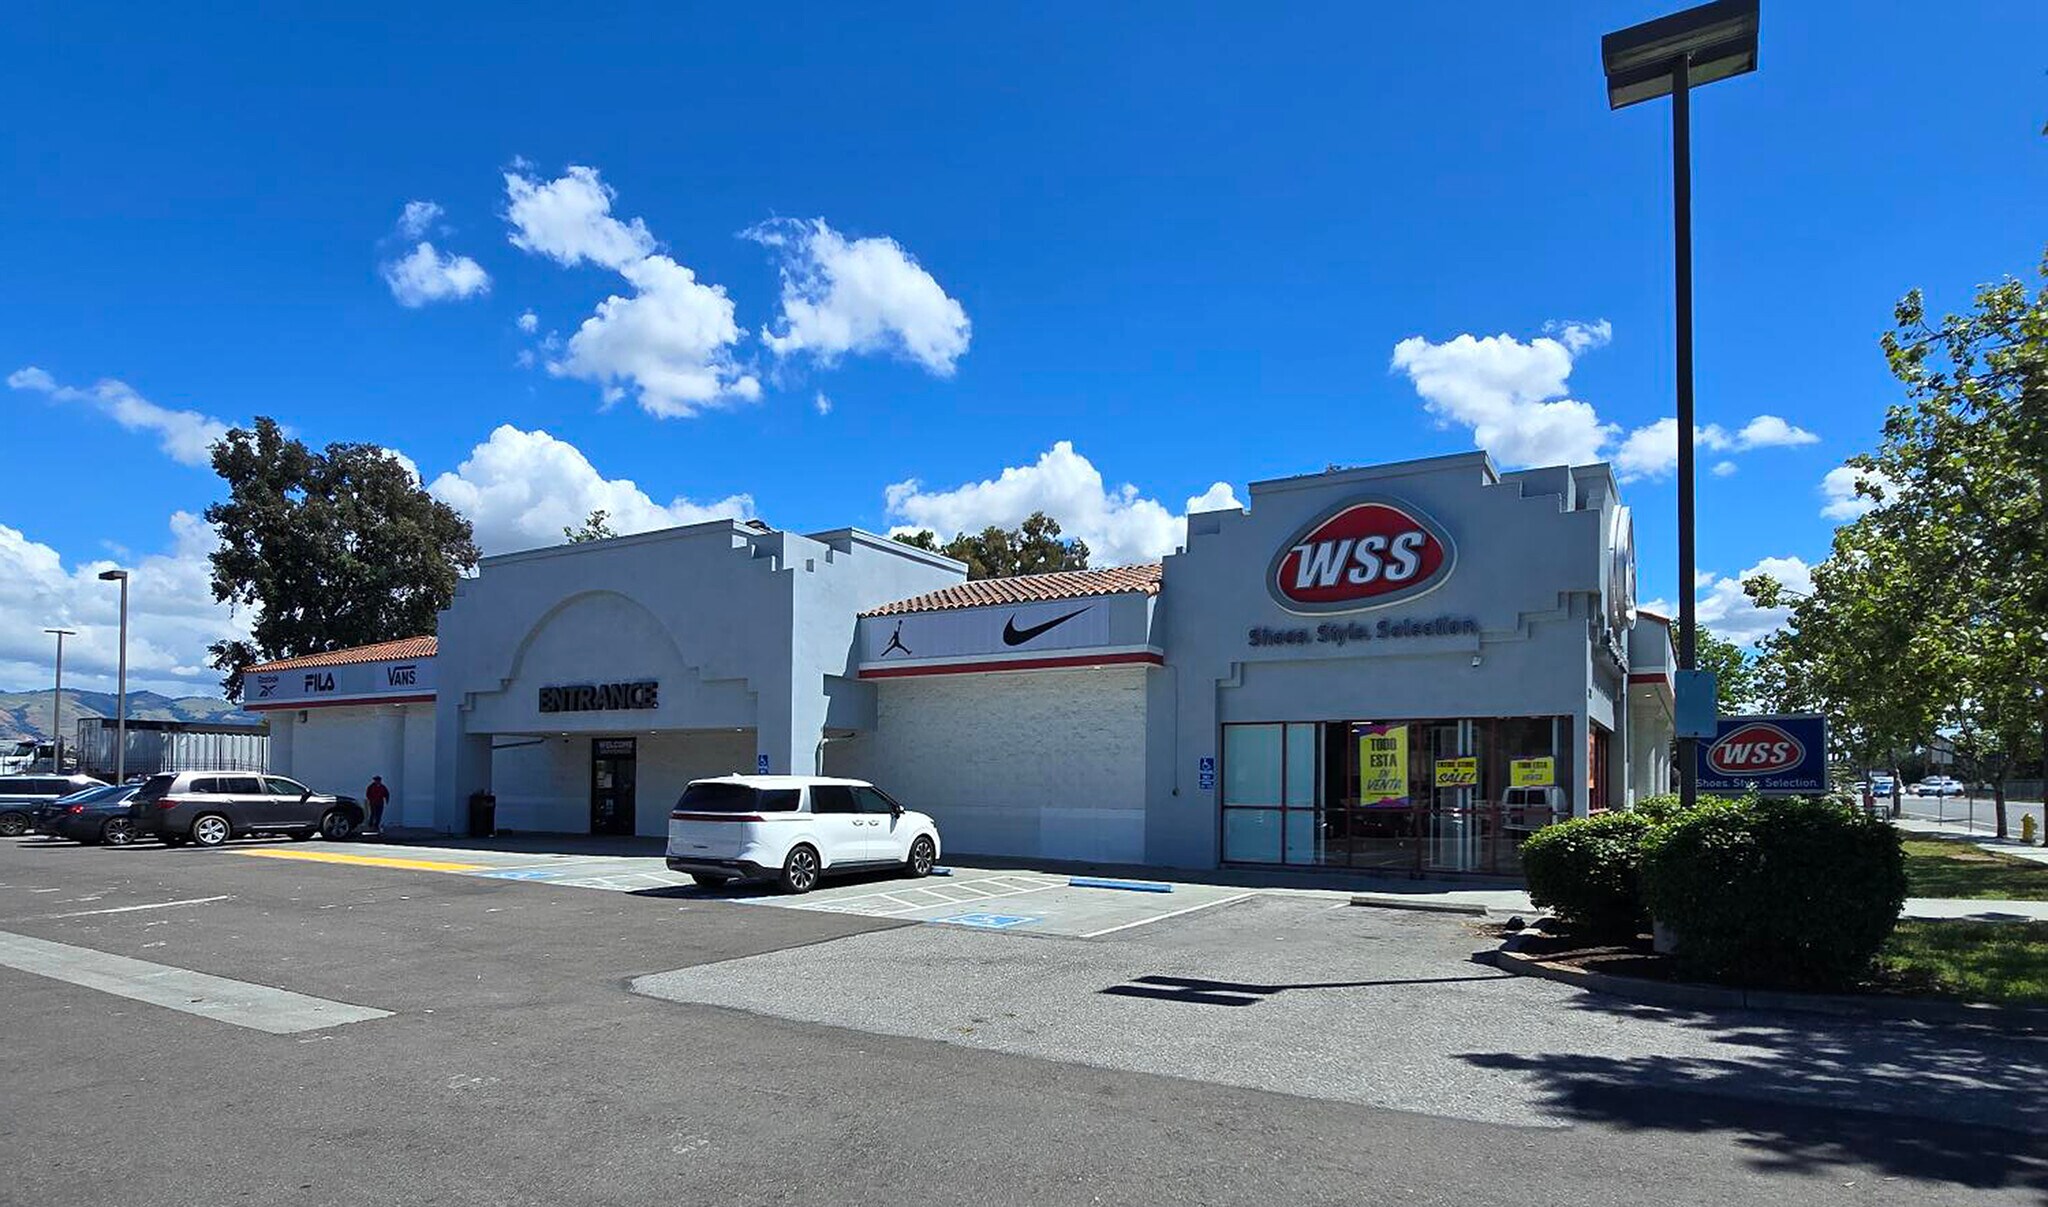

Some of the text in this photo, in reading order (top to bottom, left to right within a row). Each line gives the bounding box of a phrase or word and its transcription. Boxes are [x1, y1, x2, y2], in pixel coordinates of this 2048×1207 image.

[1291, 531, 1425, 589] WSS
[305, 672, 335, 693] FILA
[388, 665, 416, 686] VANS
[539, 682, 658, 713] ENTRANCE
[1370, 753, 1398, 767] ESTA
[1720, 741, 1790, 764] WSS
[1766, 778, 1819, 788] Selection.
